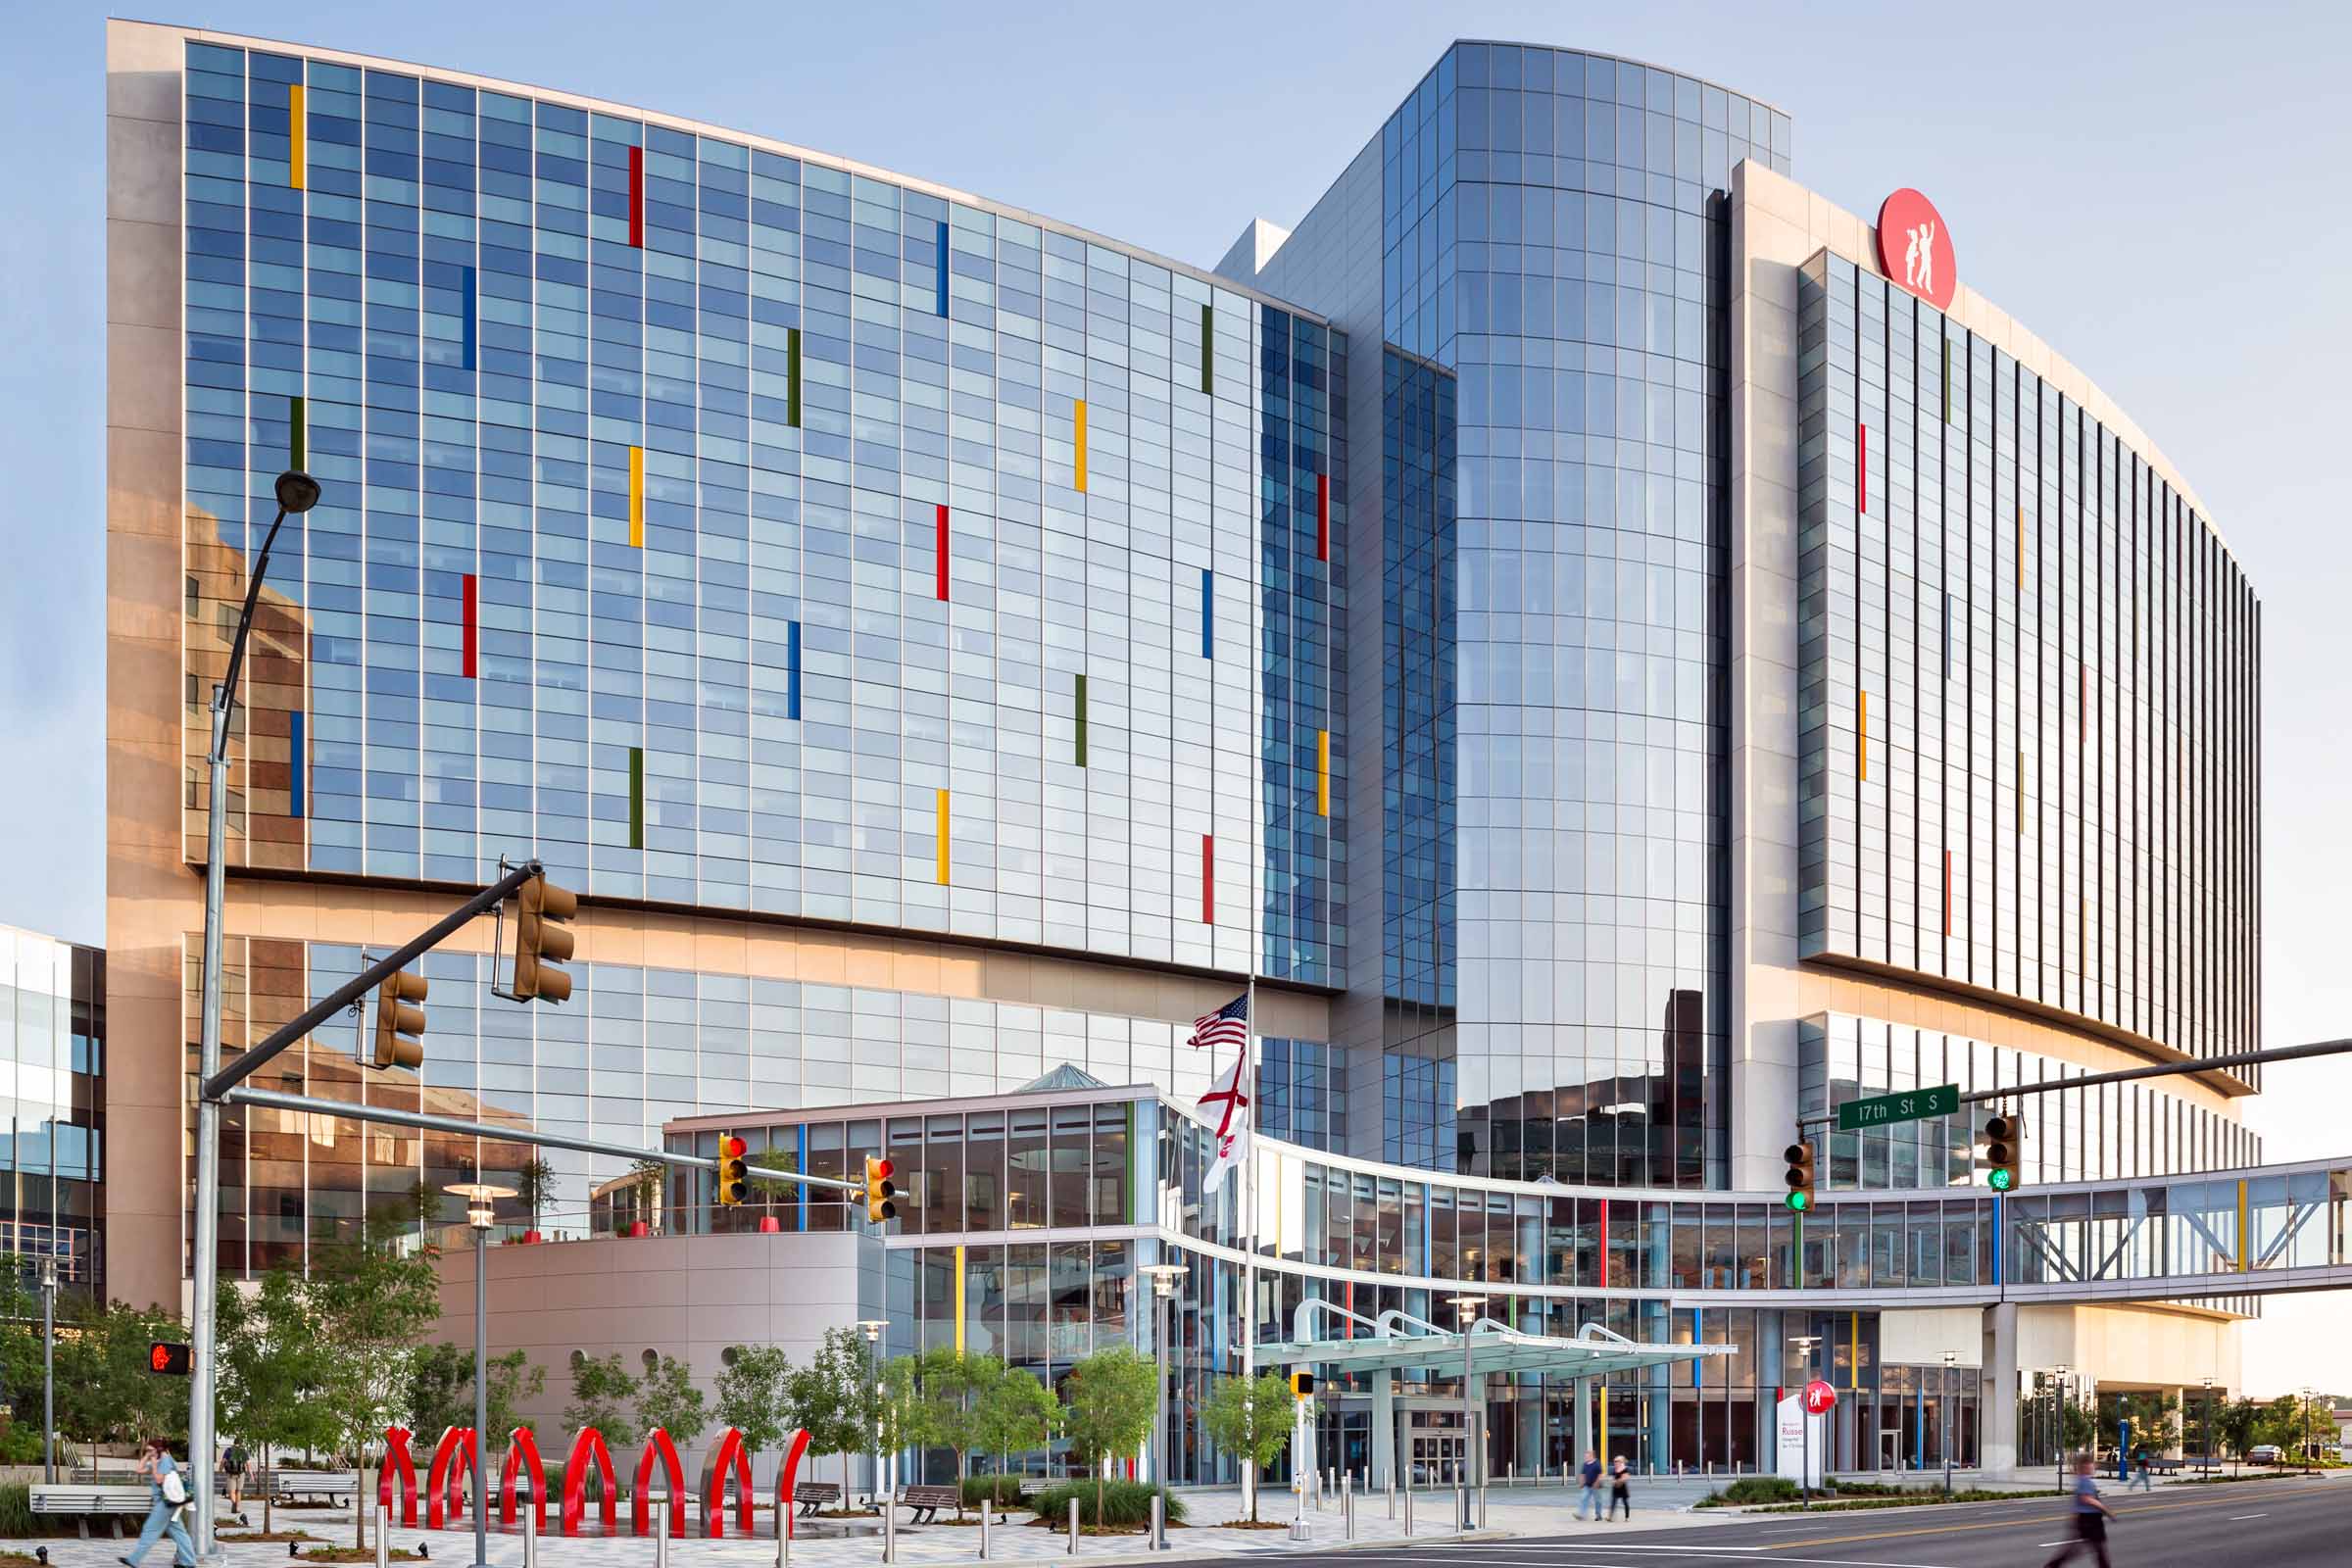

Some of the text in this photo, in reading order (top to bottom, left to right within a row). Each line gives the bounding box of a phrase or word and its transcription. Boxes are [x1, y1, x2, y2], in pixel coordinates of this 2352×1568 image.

[1859, 1095, 1937, 1121] 17th St S
